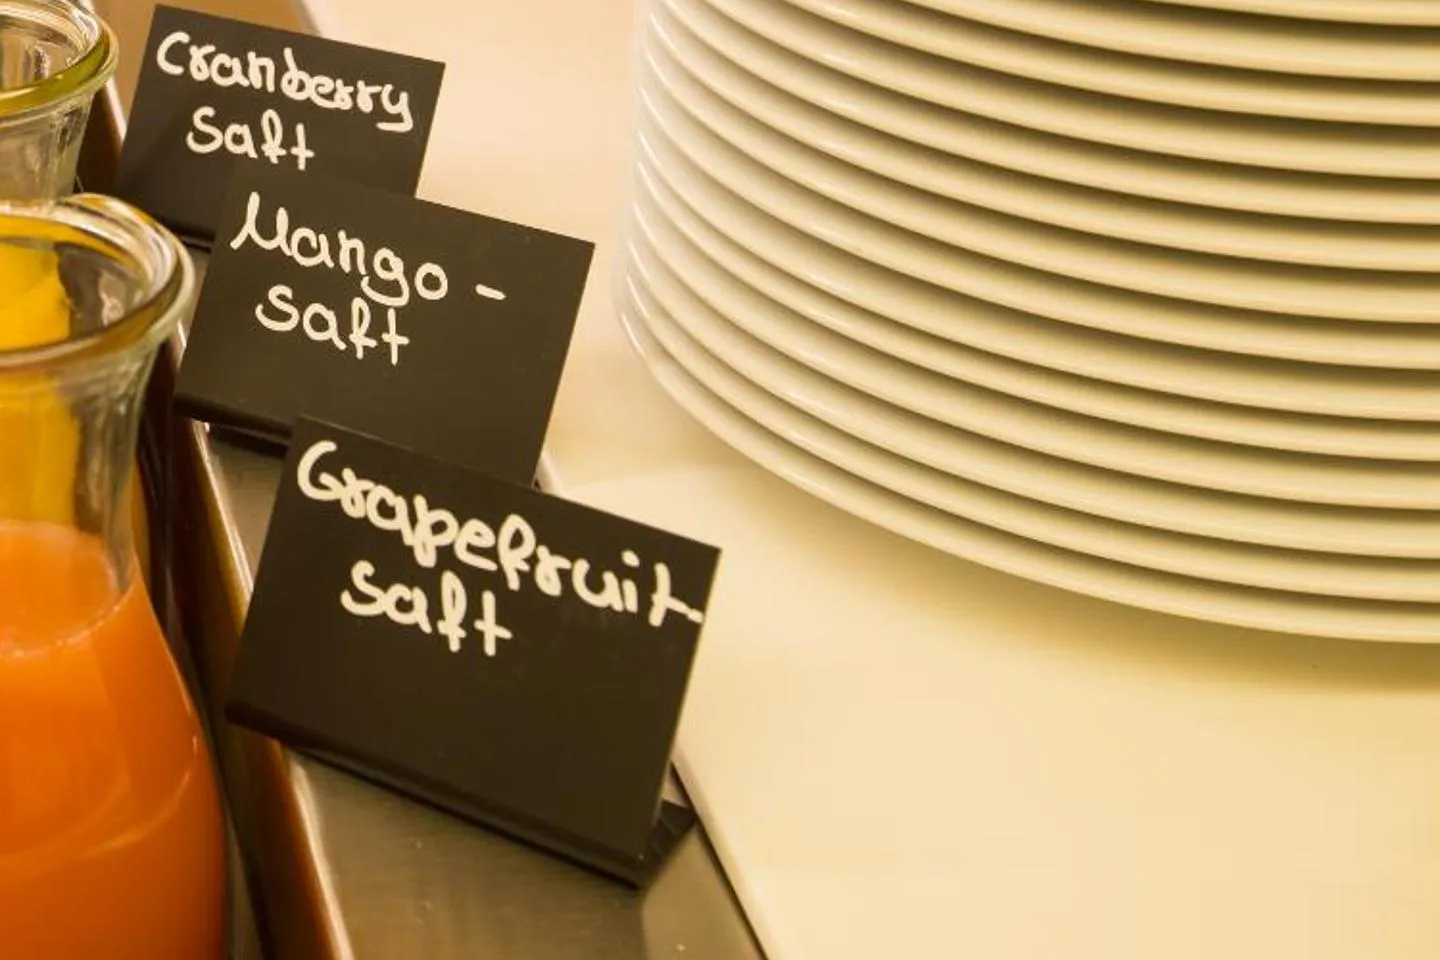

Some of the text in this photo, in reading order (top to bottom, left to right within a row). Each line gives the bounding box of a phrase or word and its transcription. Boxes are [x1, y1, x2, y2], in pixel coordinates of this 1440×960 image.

[157, 31, 414, 132] Cranberry
[230, 191, 448, 307] Mango
[297, 440, 704, 627] Grapefruit
